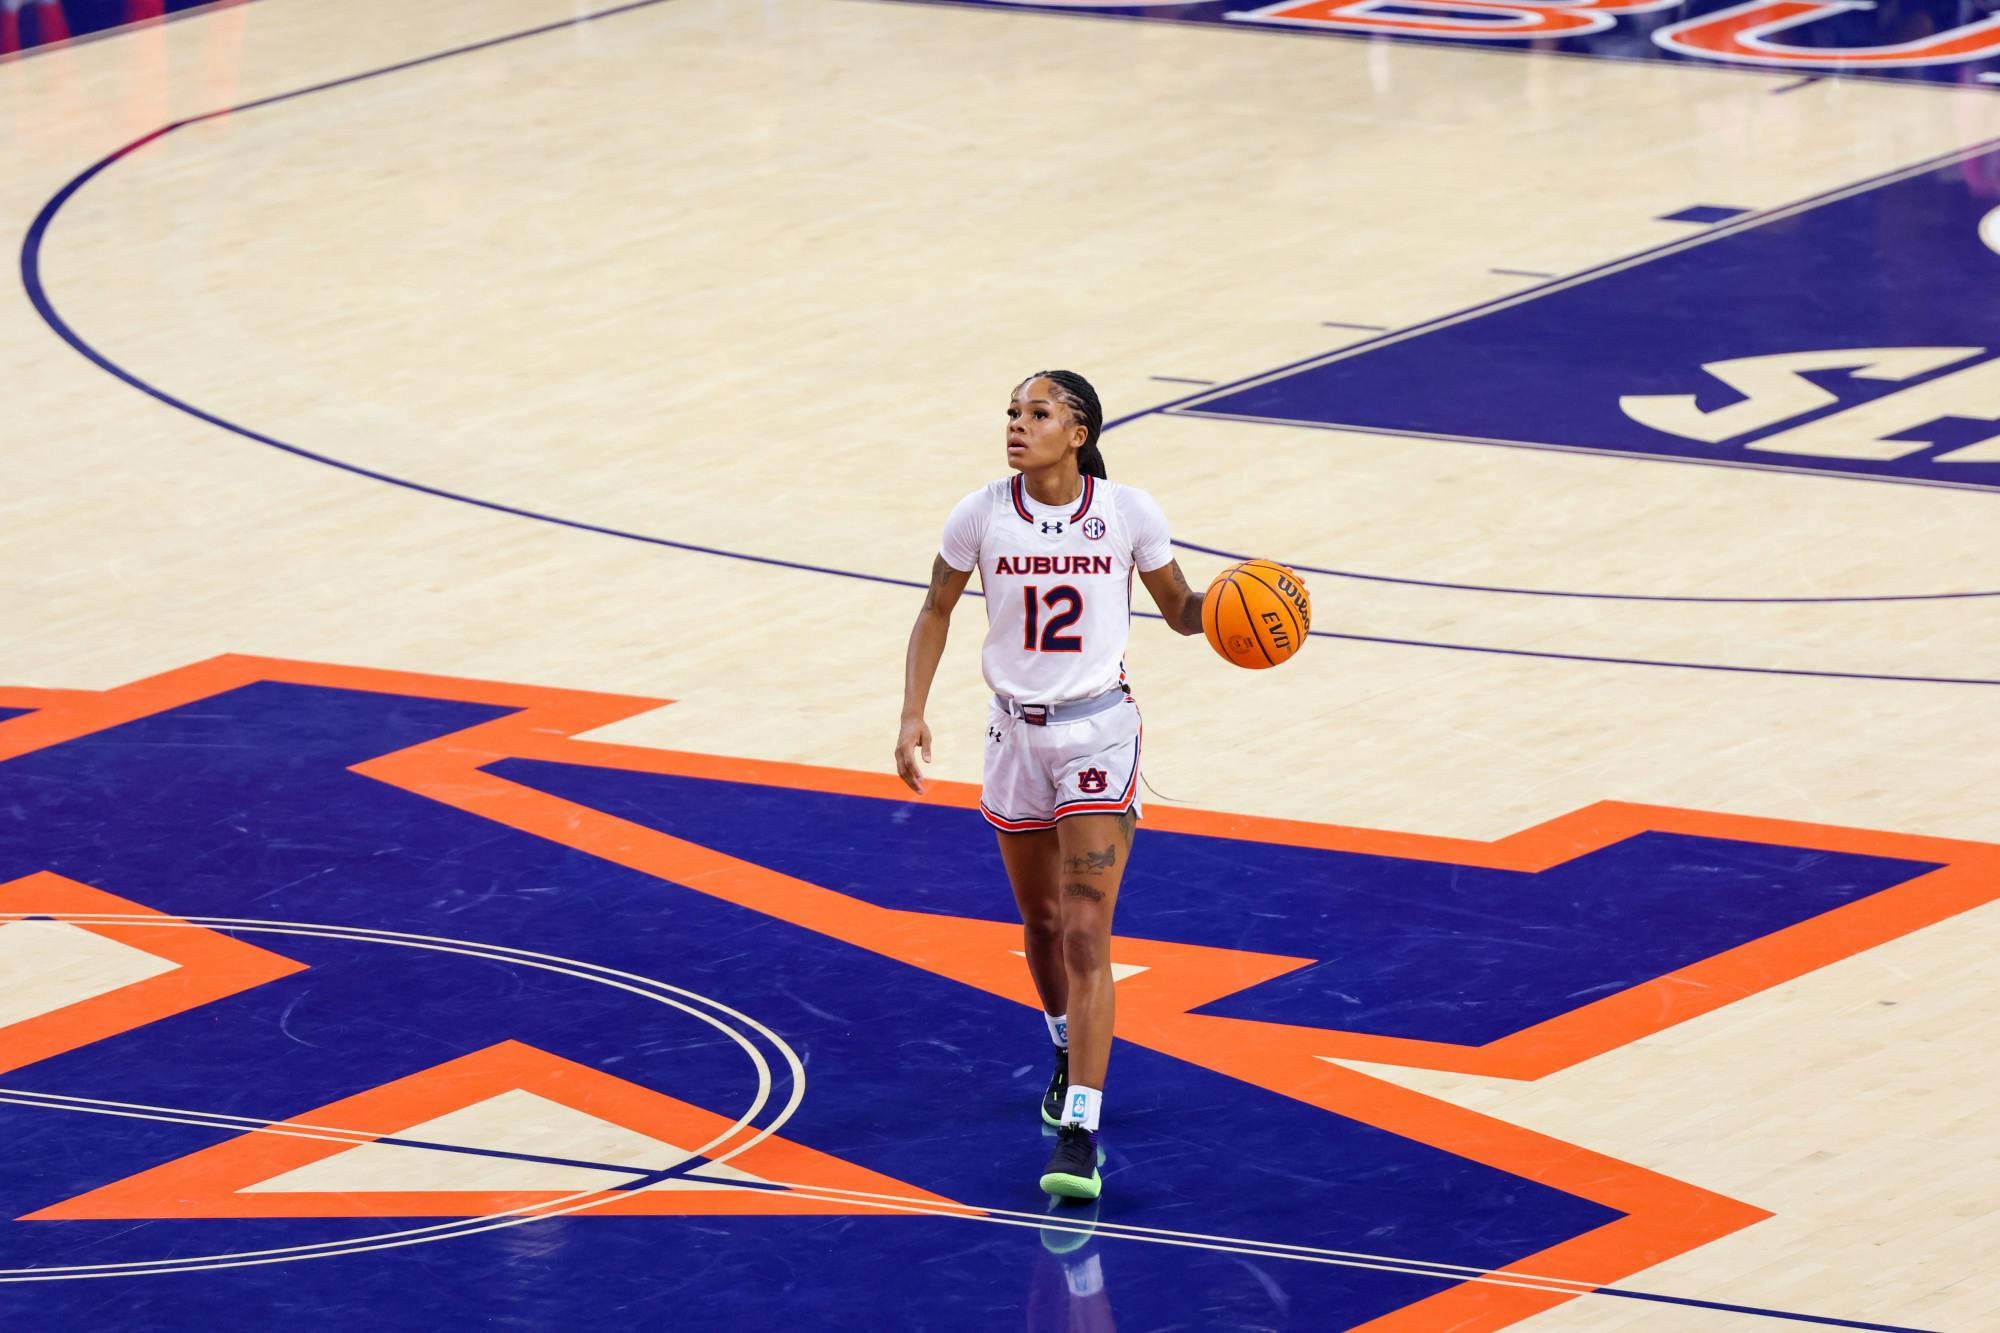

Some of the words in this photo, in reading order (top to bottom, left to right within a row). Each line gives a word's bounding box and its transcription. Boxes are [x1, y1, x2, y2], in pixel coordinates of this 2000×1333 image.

[1619, 346, 2000, 463] SE
[1084, 518, 1104, 539] SEC
[995, 556, 1112, 575] AUBURN
[1023, 584, 1084, 653] 12
